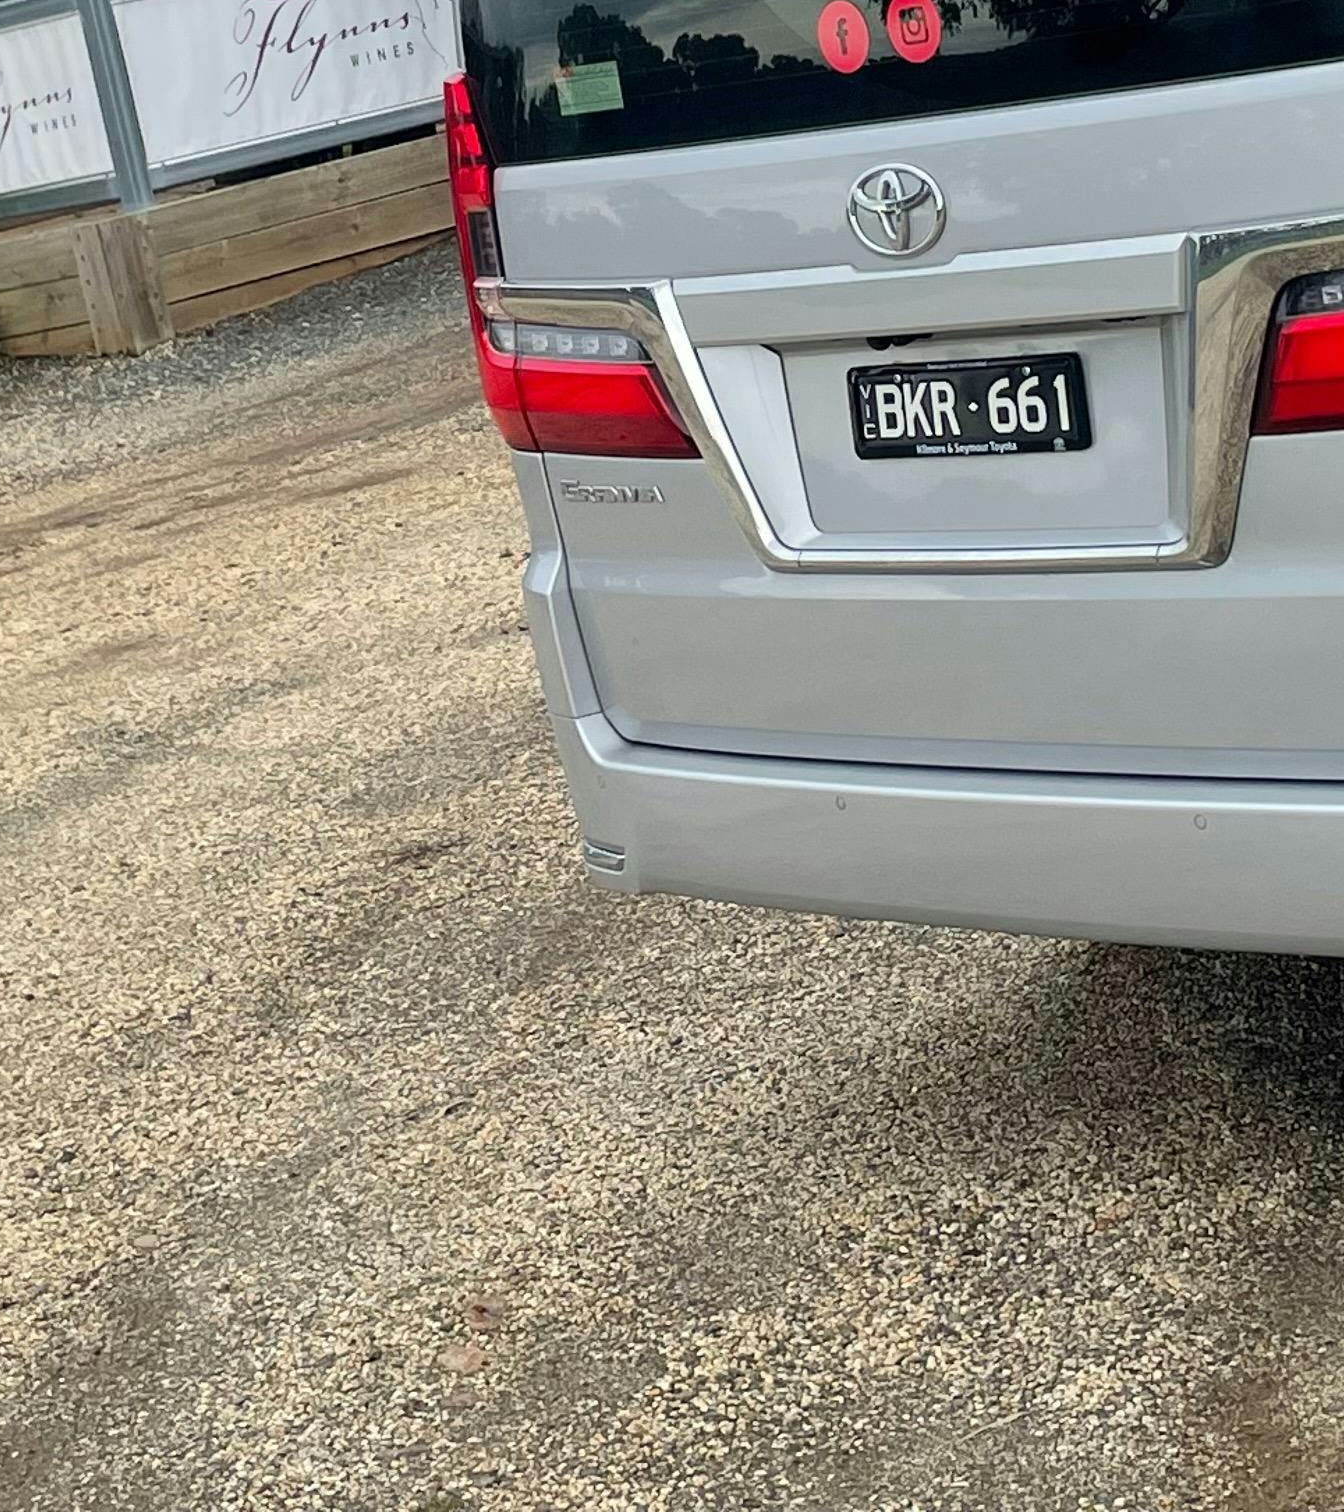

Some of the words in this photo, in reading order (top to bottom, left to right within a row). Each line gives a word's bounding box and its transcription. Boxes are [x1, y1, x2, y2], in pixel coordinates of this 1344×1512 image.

[349, 41, 416, 68] WINES
[29, 113, 78, 136] WINES
[859, 384, 877, 439] VIC
